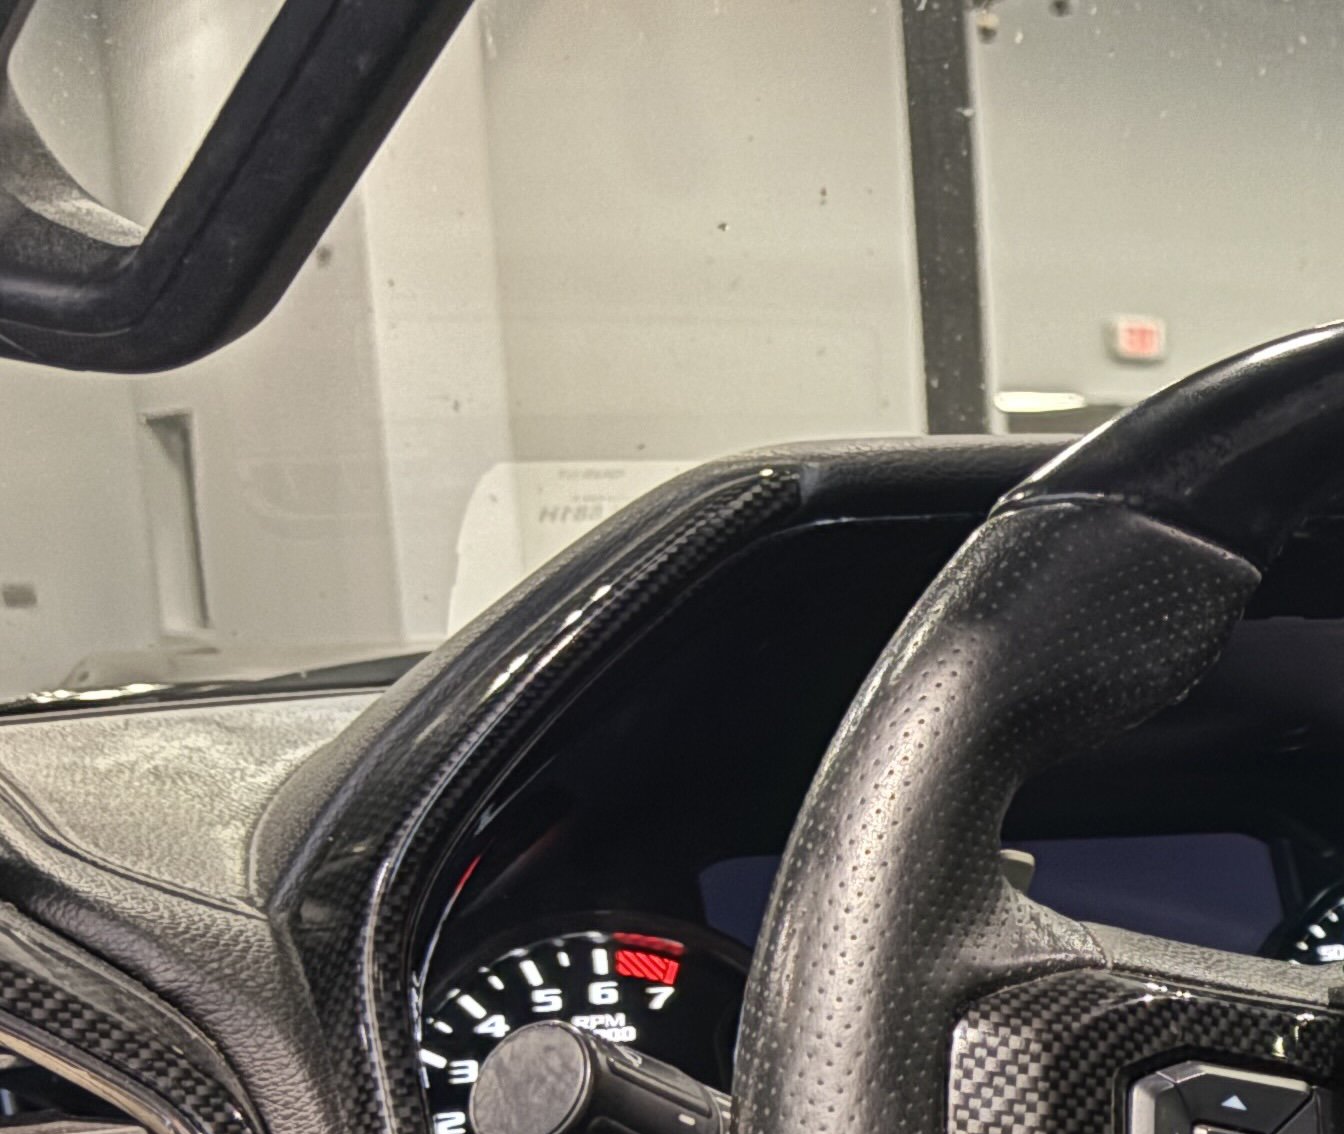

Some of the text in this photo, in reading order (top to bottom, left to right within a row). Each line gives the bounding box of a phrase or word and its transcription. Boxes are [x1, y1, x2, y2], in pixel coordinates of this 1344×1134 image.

[532, 989, 562, 1012] 5
[589, 981, 619, 1005] 6
[646, 986, 675, 1009] 7
[473, 1014, 510, 1038] 4
[571, 1013, 626, 1028] RPM
[448, 1060, 479, 1084] 3
